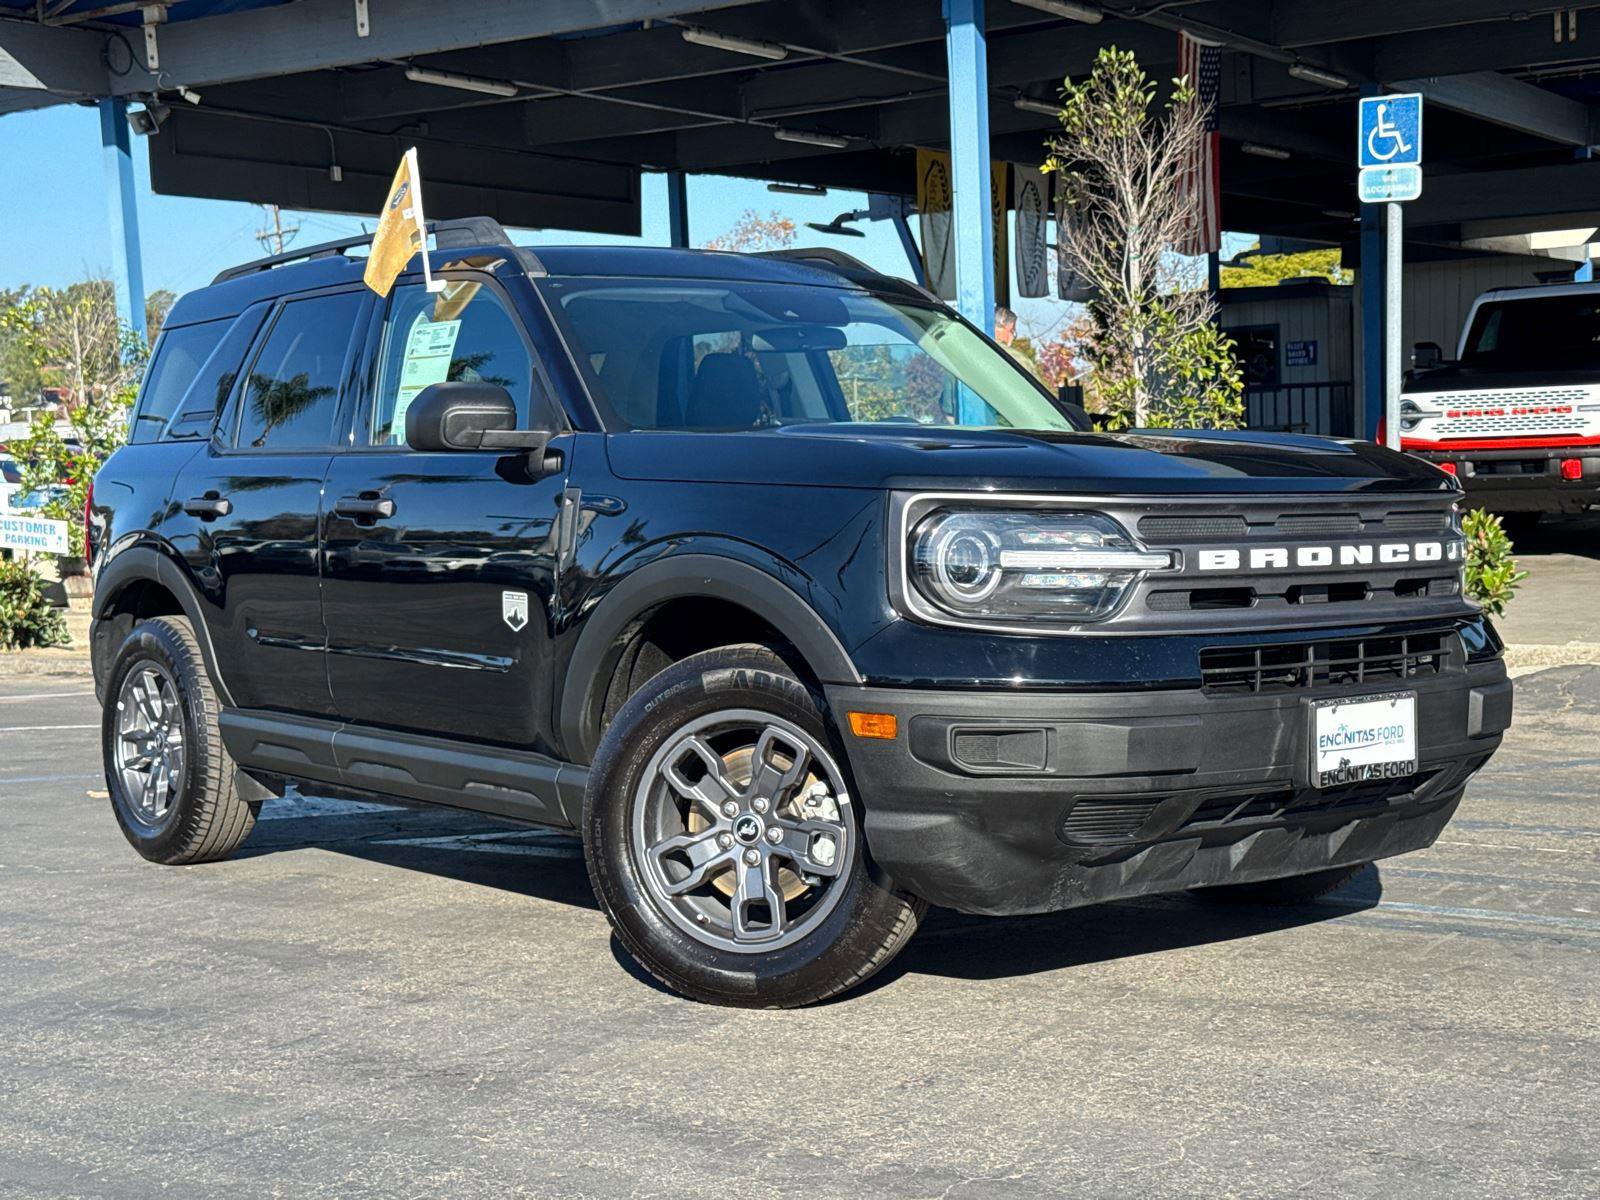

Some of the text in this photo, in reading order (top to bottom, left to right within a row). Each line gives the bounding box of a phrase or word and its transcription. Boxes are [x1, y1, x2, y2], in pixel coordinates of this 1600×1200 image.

[1446, 405, 1572, 418] BRONCO
[5, 533, 48, 547] PARKING
[1199, 542, 1442, 570] BRONCO
[1319, 725, 1404, 748] ENCINITAS FORD
[1320, 761, 1414, 786] ENCINITAS FORD
